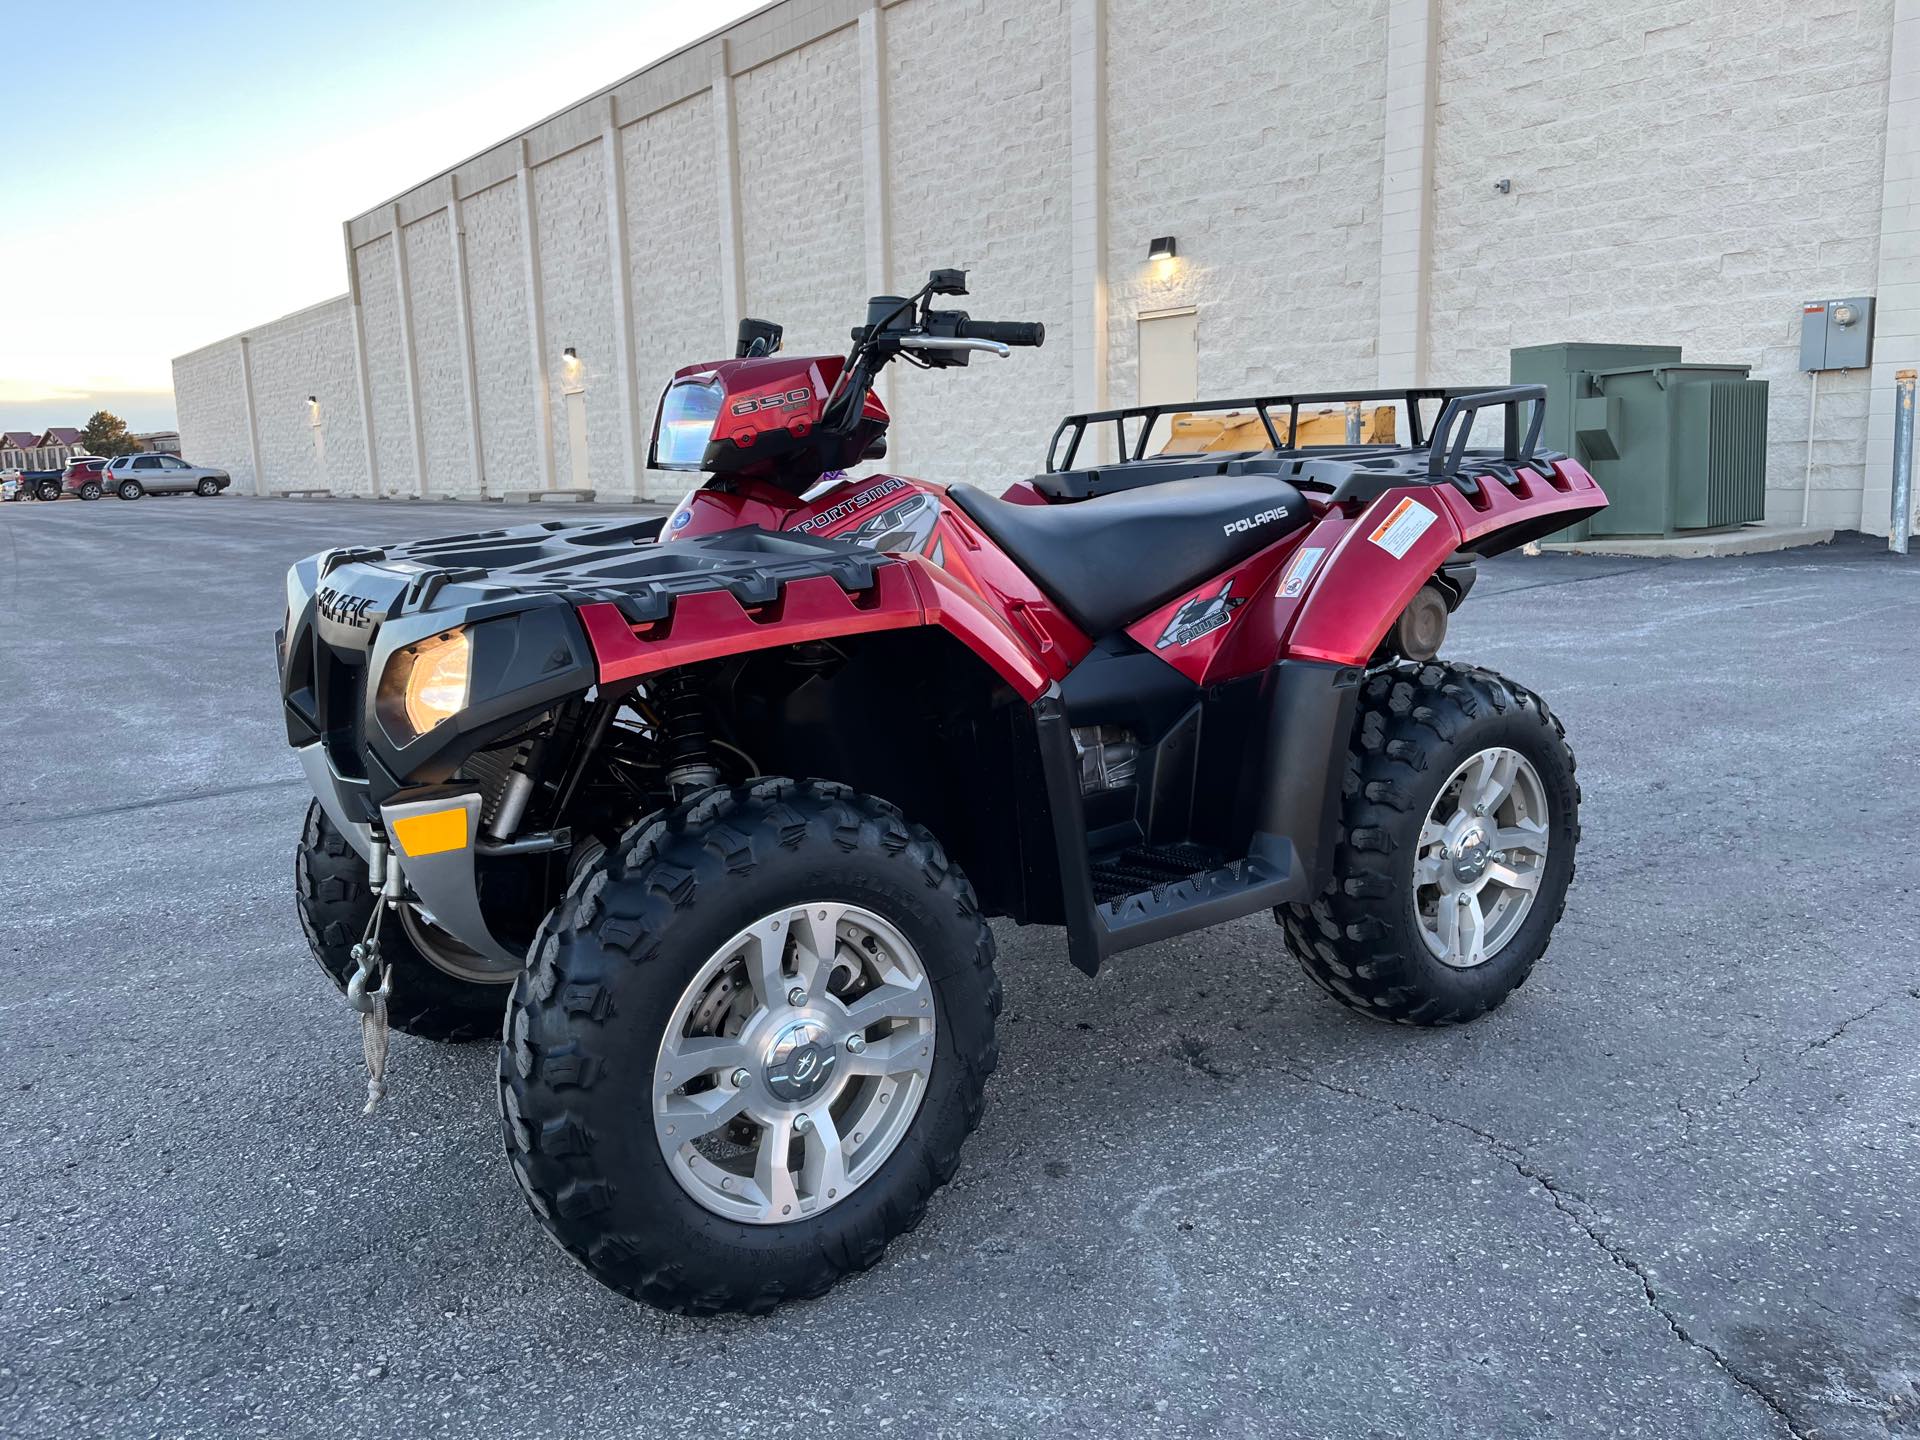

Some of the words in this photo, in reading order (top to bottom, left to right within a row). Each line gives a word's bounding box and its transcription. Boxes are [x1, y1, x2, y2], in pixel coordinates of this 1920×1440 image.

[731, 388, 811, 416] 850
[834, 493, 927, 546] XP
[1223, 506, 1289, 537] POLARIS
[1177, 611, 1231, 647] AWD
